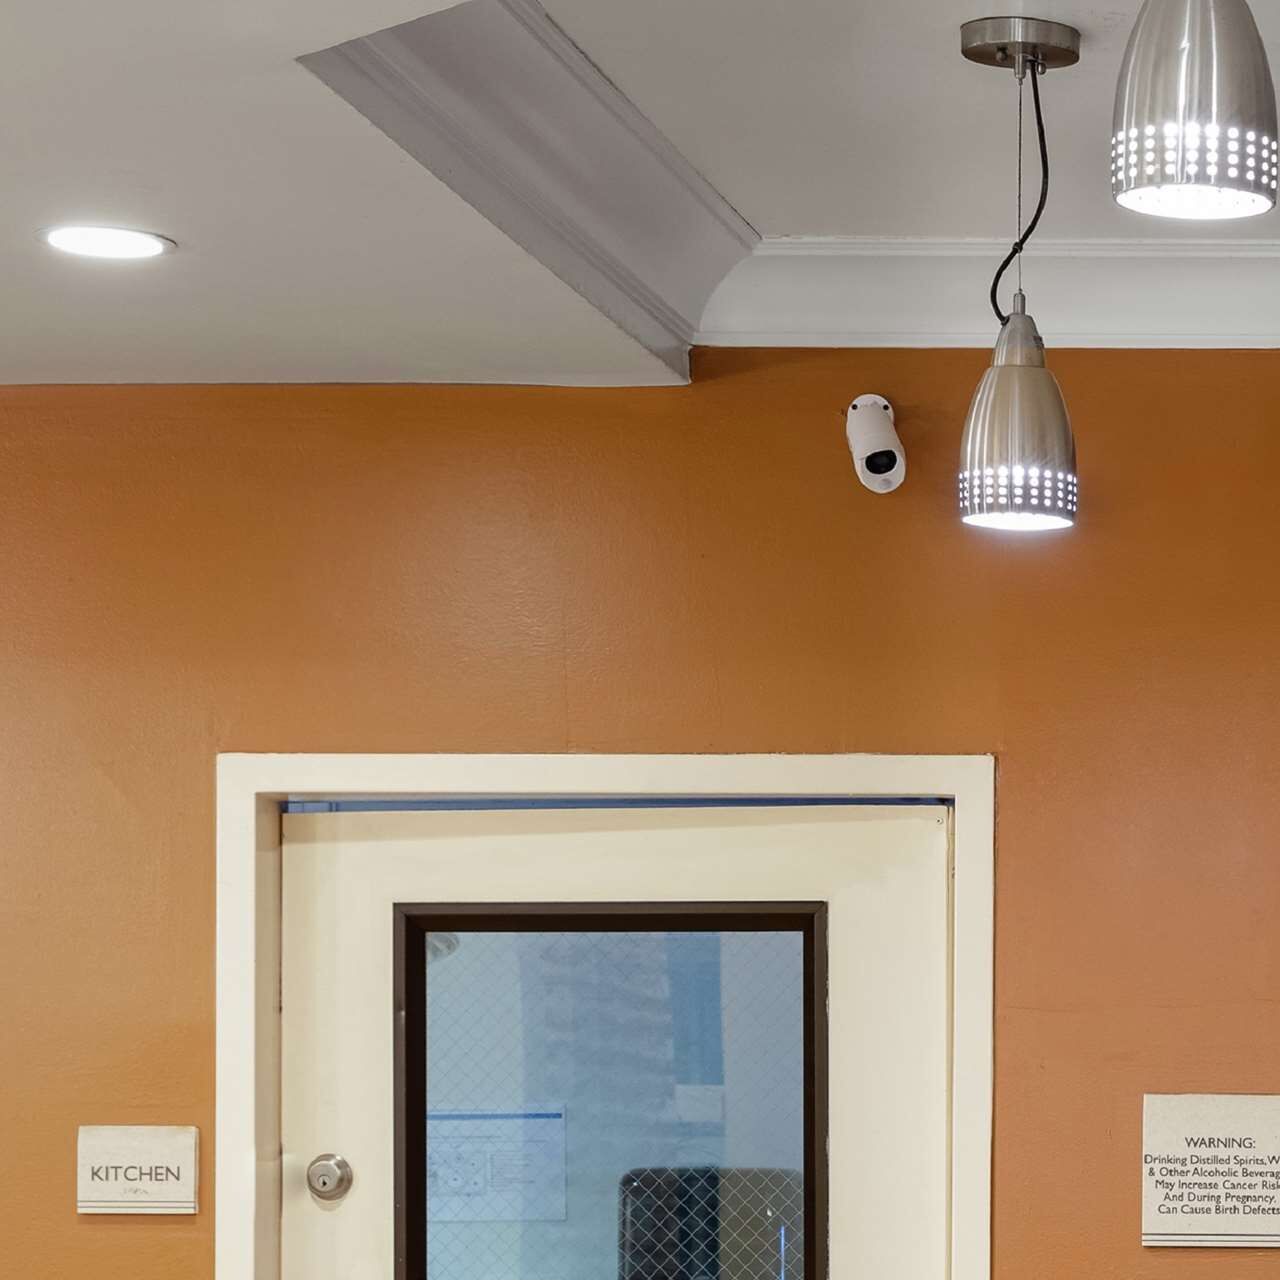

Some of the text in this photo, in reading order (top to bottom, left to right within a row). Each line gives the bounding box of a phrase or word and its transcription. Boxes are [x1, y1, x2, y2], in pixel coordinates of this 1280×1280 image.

[1185, 1137, 1256, 1149] WARNING:
[1144, 1154, 1187, 1167] Drinking
[1190, 1154, 1231, 1165] Distilled
[1233, 1154, 1267, 1167] Spirits,
[91, 1166, 180, 1182] KITCHEN
[1148, 1167, 1156, 1177] &
[1159, 1167, 1190, 1177] Other
[1192, 1167, 1239, 1177] Alcoholic
[1155, 1180, 1175, 1192] May
[1178, 1180, 1219, 1190] Increase
[1222, 1180, 1258, 1190] Cancer
[1163, 1192, 1184, 1202] And
[1187, 1192, 1222, 1204] During
[1158, 1204, 1280, 1215] Can Cause Birth Defects
